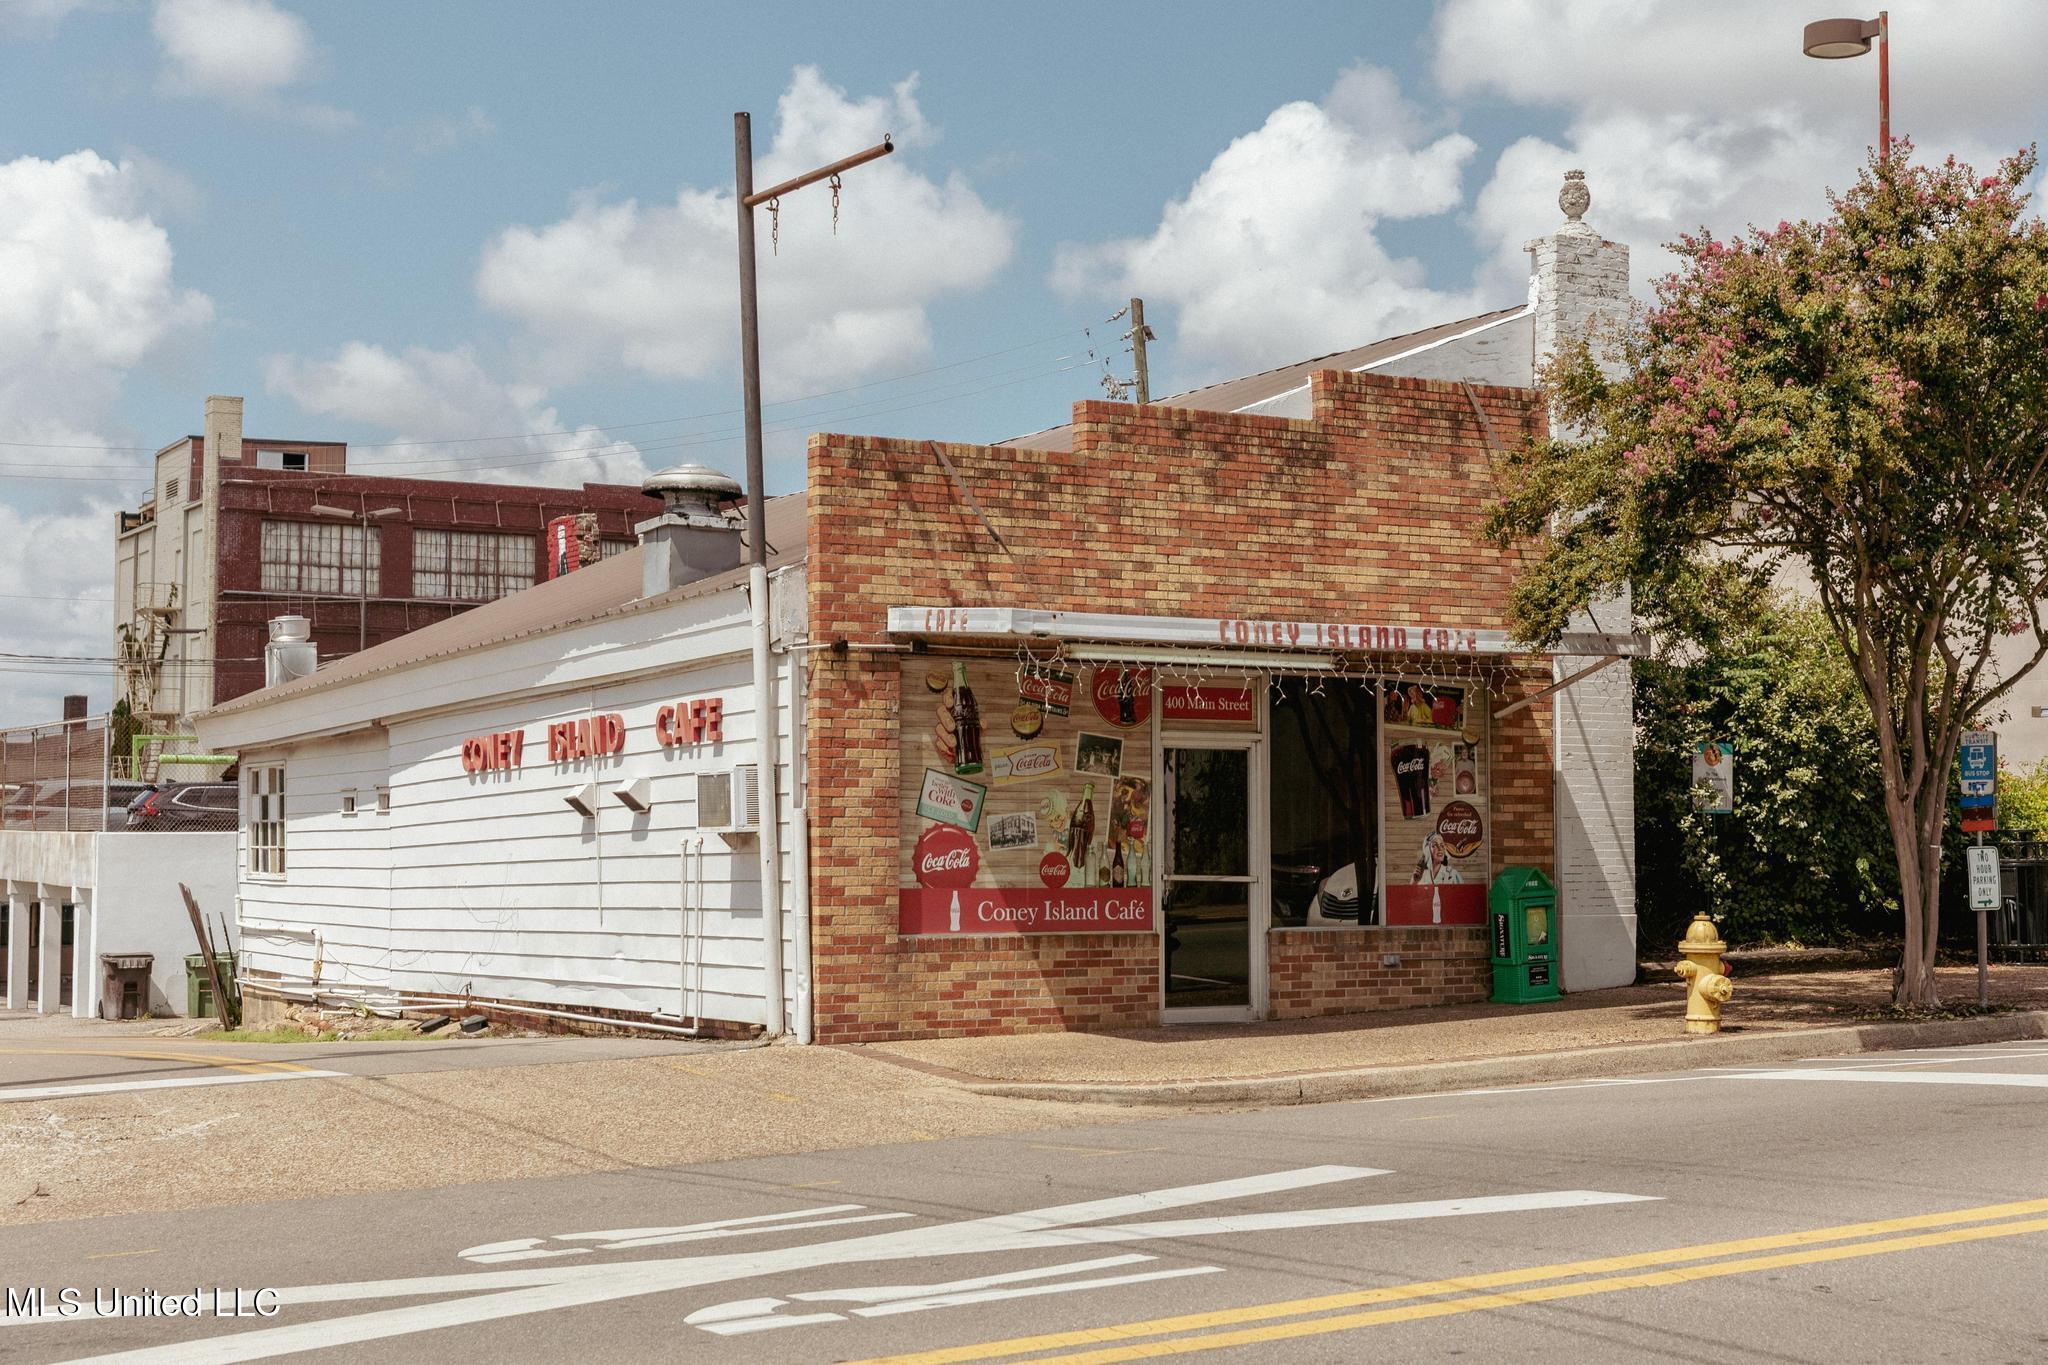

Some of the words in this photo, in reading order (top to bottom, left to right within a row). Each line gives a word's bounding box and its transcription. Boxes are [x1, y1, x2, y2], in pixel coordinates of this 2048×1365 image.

[1219, 620, 1300, 646] CONEY
[1316, 624, 1408, 652] ISLAND
[1097, 677, 1151, 701] Coca-Cola
[1165, 696, 1185, 710] 400
[1187, 697, 1216, 710] Main
[1218, 697, 1250, 711] Street
[461, 729, 524, 773] CONEY
[547, 713, 626, 762] ISLAND
[655, 697, 723, 747] CAFE
[1016, 754, 1052, 771] Coca-Cola
[1397, 758, 1425, 774] Coca-Cola
[1976, 769, 1990, 777] STOP
[928, 789, 956, 808] Coke
[1440, 819, 1479, 834] Coca-Cola
[922, 848, 971, 873] Coca-Cola
[1977, 853, 1989, 862] TWO
[1041, 864, 1067, 876] Coca-Cola
[1976, 865, 1992, 873] HOUR
[1972, 876, 1997, 885] PARKING
[1978, 888, 1992, 896] ONLY
[977, 900, 1039, 925] Coney
[1044, 900, 1099, 921] Island
[1105, 900, 1145, 921] Café
